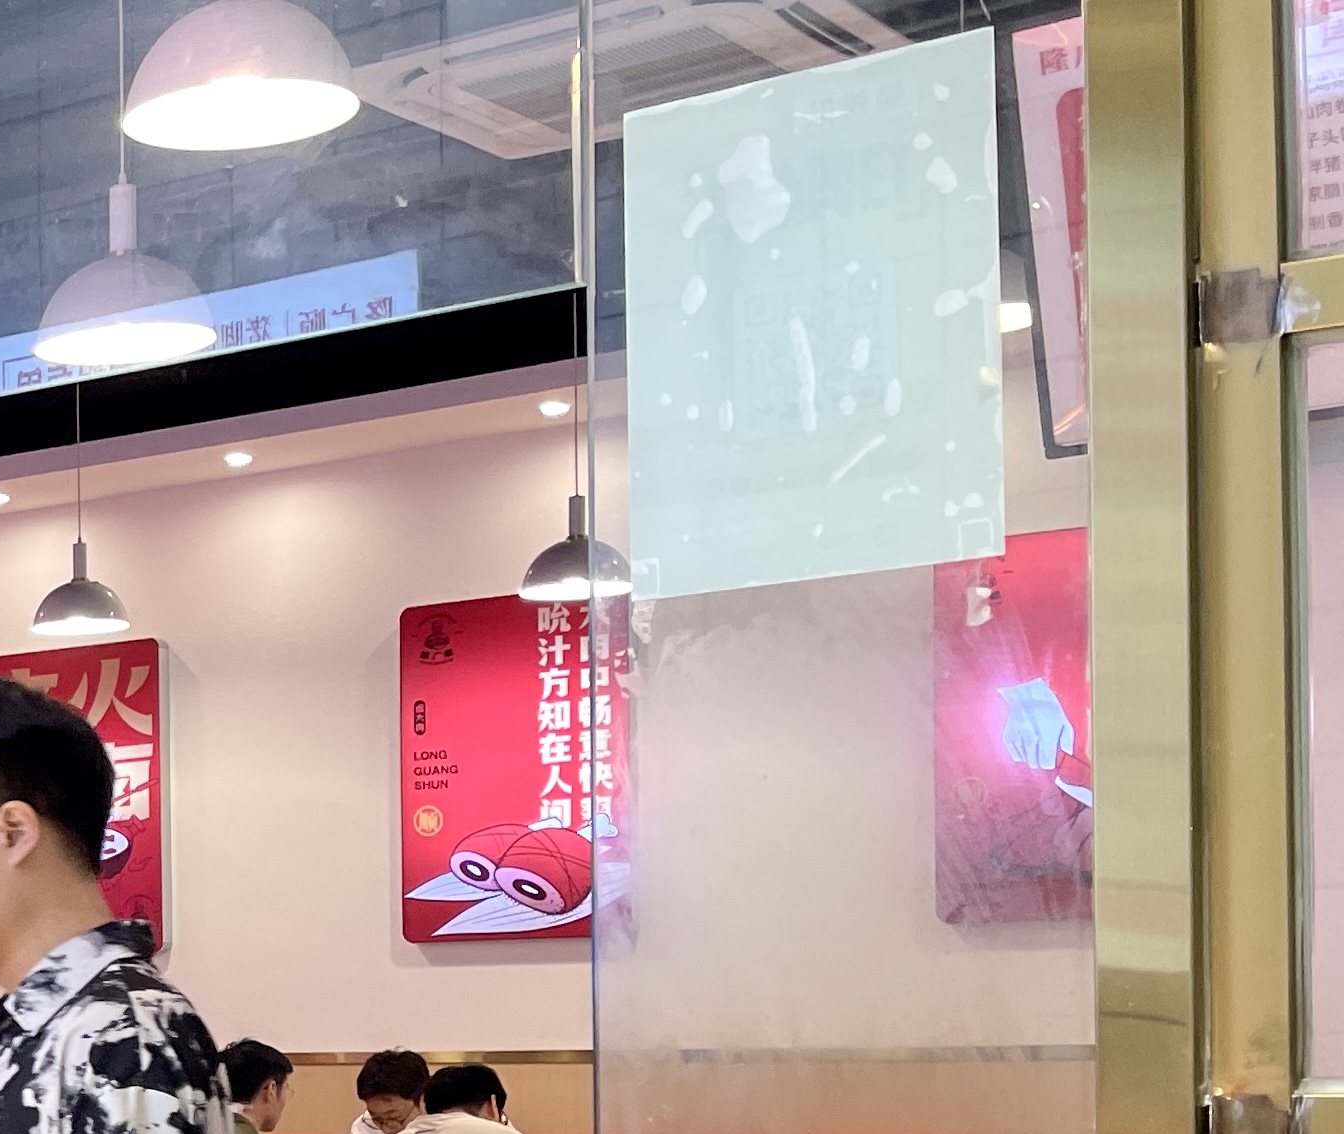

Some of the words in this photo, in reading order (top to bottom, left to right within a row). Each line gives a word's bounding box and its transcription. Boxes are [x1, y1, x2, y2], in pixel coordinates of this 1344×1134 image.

[537, 603, 573, 829] 吮汁方知在人间
[413, 749, 448, 761] LONG
[413, 764, 460, 777] GUANG
[414, 778, 449, 790] SHUN
